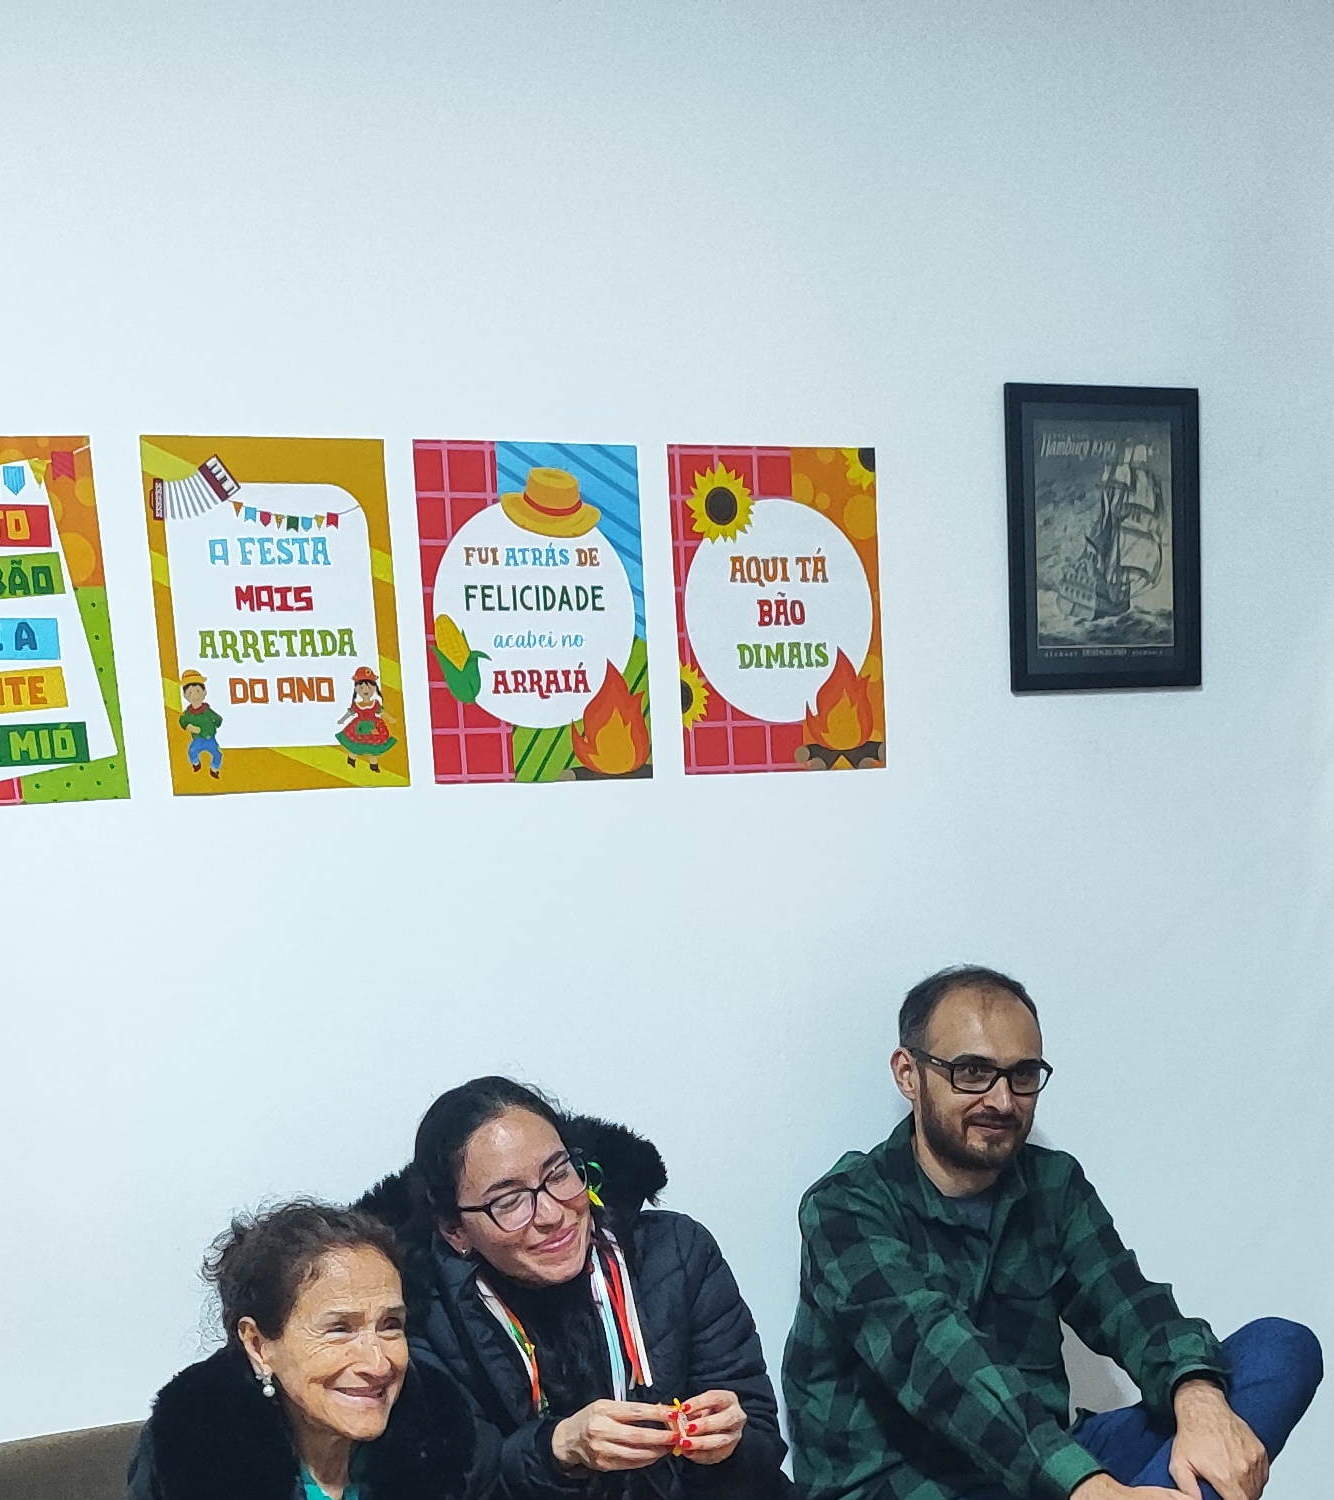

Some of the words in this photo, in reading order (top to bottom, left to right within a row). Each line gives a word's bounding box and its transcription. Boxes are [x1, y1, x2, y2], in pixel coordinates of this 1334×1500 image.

[208, 538, 230, 566] A
[236, 536, 332, 566] FESTA
[463, 546, 500, 566] FUI
[504, 542, 570, 567] ATRÁS
[575, 547, 600, 567] DE
[730, 555, 791, 587] AQUI
[795, 547, 829, 583] TÁ
[234, 585, 314, 612] MAIS
[463, 585, 606, 611] FELICIDADE
[757, 591, 806, 627] BÃO
[14, 621, 38, 651] A
[198, 628, 358, 663] ARRETADA
[493, 630, 558, 649] acabei
[561, 633, 585, 648] no
[737, 642, 829, 669] DIMAIS
[228, 677, 269, 704] DO
[277, 676, 336, 703] ANO
[492, 661, 592, 699] ARRAIÁ
[9, 723, 77, 762] MIÓ
